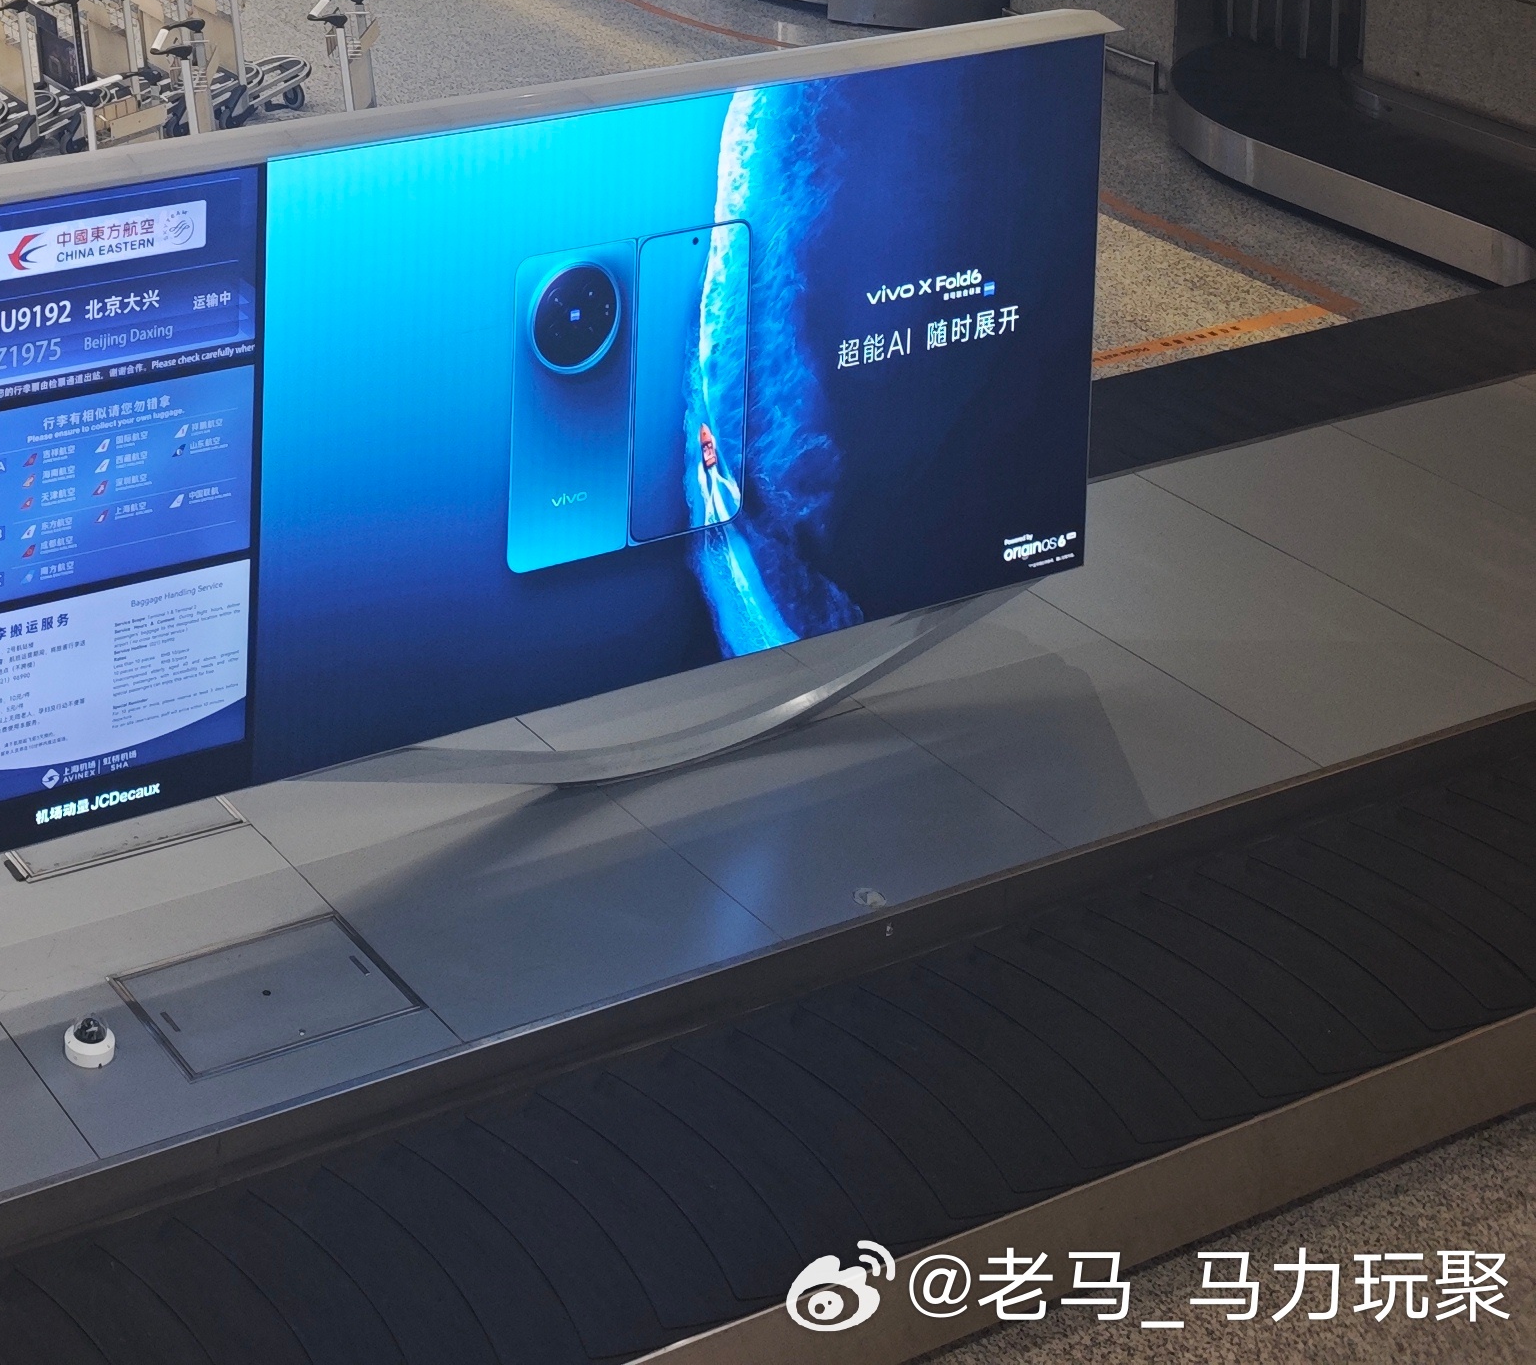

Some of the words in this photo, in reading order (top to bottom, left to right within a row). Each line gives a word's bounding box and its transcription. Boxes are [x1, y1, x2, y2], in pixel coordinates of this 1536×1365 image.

[56, 218, 155, 247] 中國東方航空
[56, 247, 95, 263] CHINA
[98, 237, 155, 256] EASTERN
[866, 284, 915, 305] vivo
[919, 278, 932, 295] X
[935, 269, 982, 292] Fold6
[84, 289, 160, 320] 北京大兴
[192, 290, 232, 311] 运输中
[84, 332, 126, 351] Beijing
[130, 324, 173, 343] Daxing
[837, 327, 911, 369] 超能AI
[926, 305, 1020, 351] 随时展开
[151, 358, 176, 369] Please
[177, 353, 200, 365] check
[201, 346, 234, 360] carefully
[27, 434, 52, 444] Please
[54, 428, 80, 438] ensure
[551, 491, 588, 507] vivo
[131, 595, 163, 607] Baggage
[164, 587, 196, 600] Handling
[198, 581, 224, 592] Service
[63, 769, 96, 784] AVINEX
[111, 762, 129, 771] SHA
[35, 798, 90, 825] 机场动量
[91, 783, 161, 810] JCDecaux
